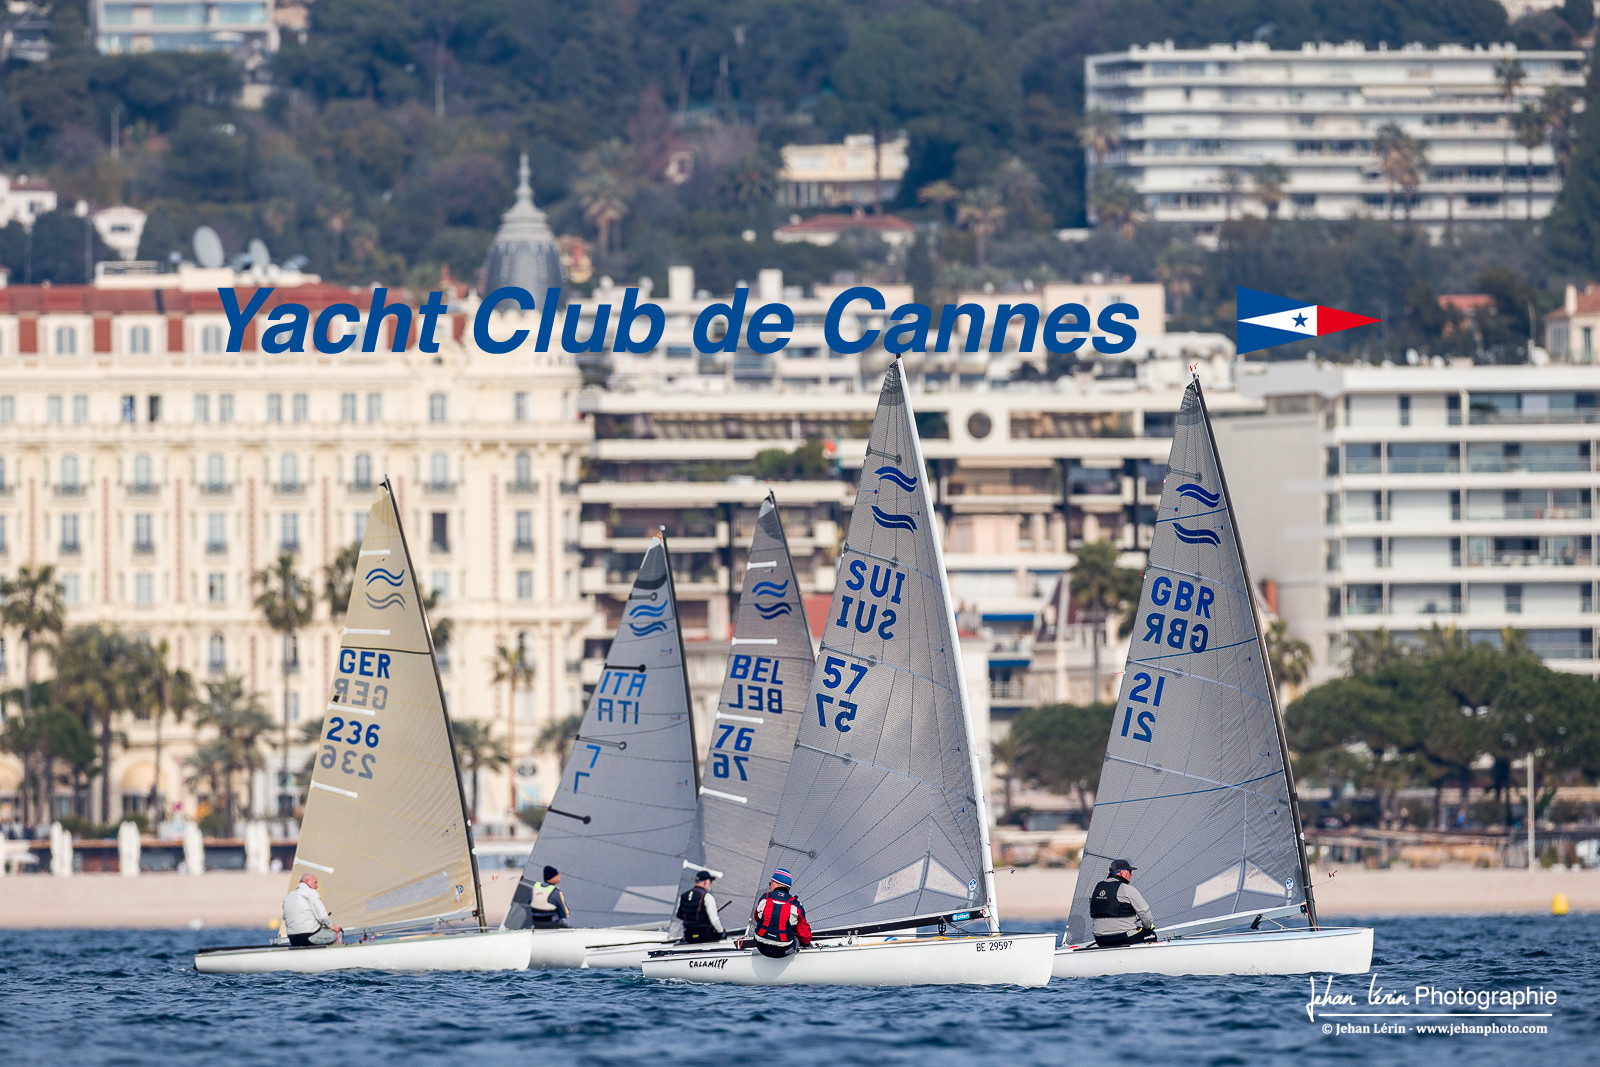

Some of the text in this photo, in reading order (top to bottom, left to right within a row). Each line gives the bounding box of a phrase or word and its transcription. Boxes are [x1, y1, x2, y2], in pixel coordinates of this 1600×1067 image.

[845, 559, 906, 605] SUI
[1150, 575, 1215, 620] GBR
[339, 648, 392, 679] GER
[729, 653, 784, 686] BEL
[822, 655, 869, 695] 57
[599, 670, 648, 698] ITA
[1128, 671, 1166, 708] 21
[326, 716, 381, 748] 236
[714, 723, 756, 753] 76
[585, 743, 602, 769] 7
[976, 940, 1013, 952] BE 29597
[689, 959, 728, 970] CALAMITY
